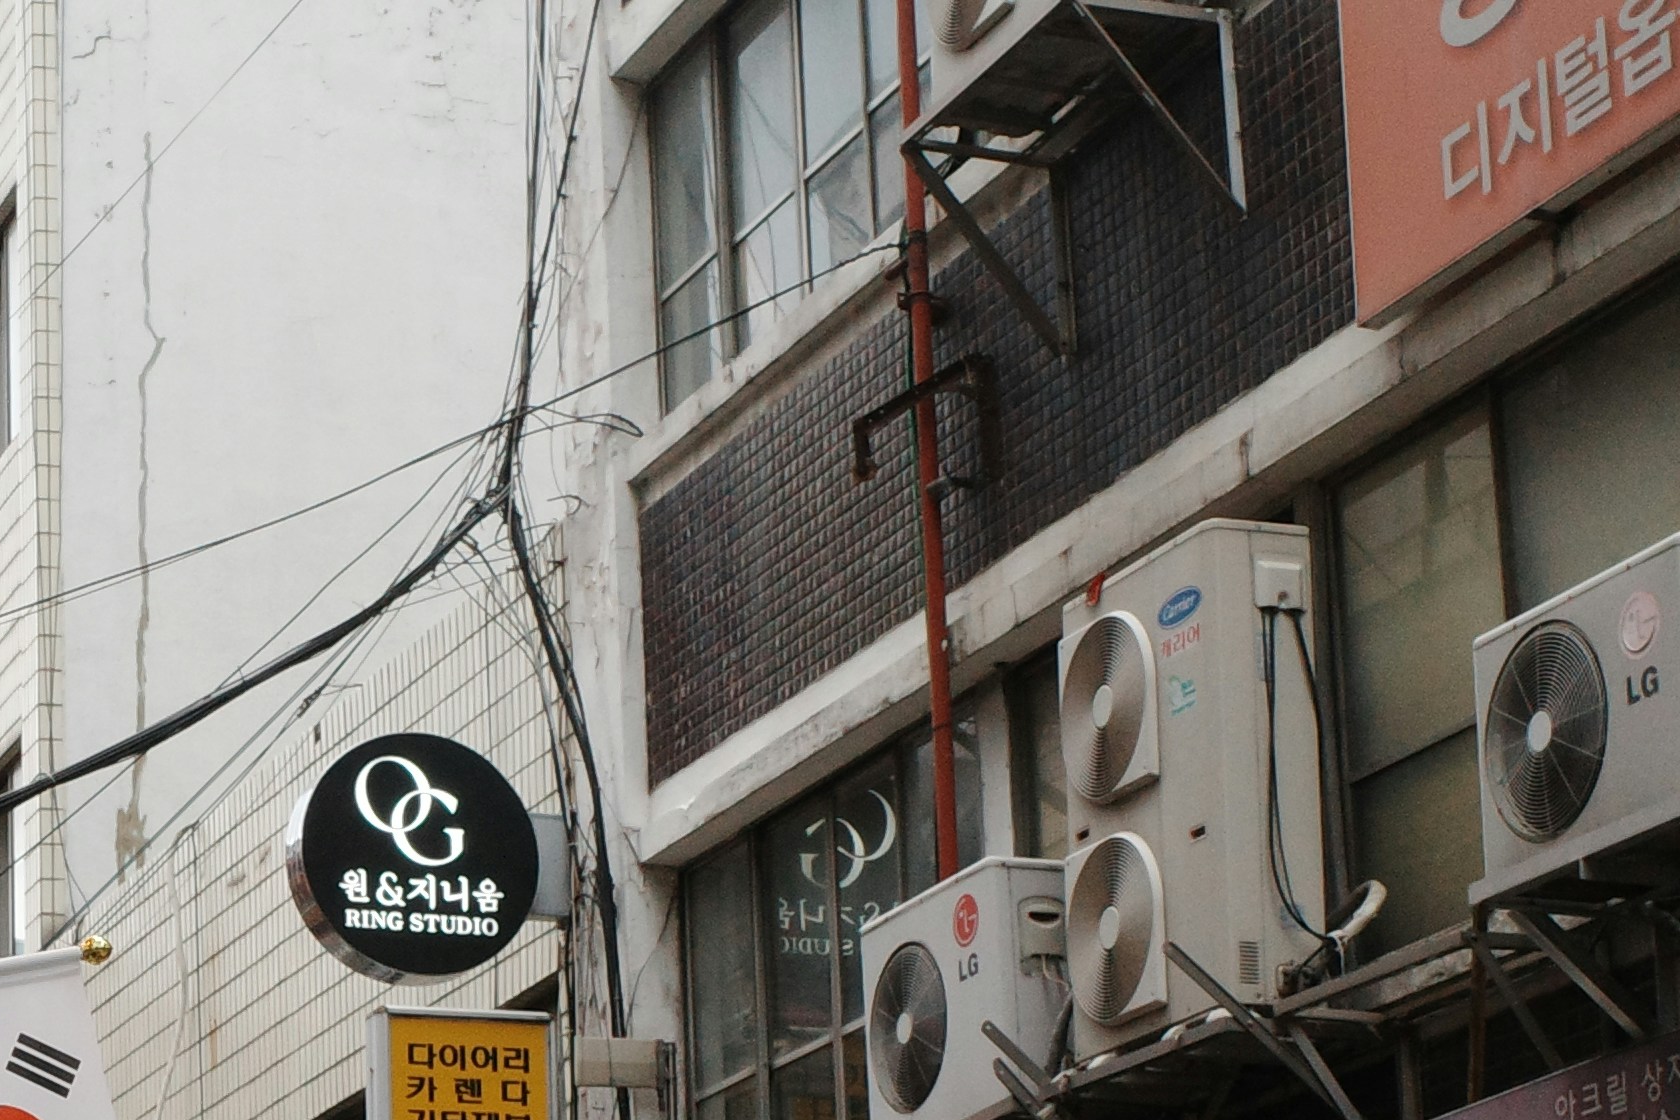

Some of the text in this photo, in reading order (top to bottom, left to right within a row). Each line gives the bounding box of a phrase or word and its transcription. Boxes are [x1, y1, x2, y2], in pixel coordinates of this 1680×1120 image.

[1625, 666, 1660, 705] LG
[345, 909, 499, 937] RING STUDIO
[958, 953, 979, 982] LG
[407, 1043, 530, 1074] 다이어리
